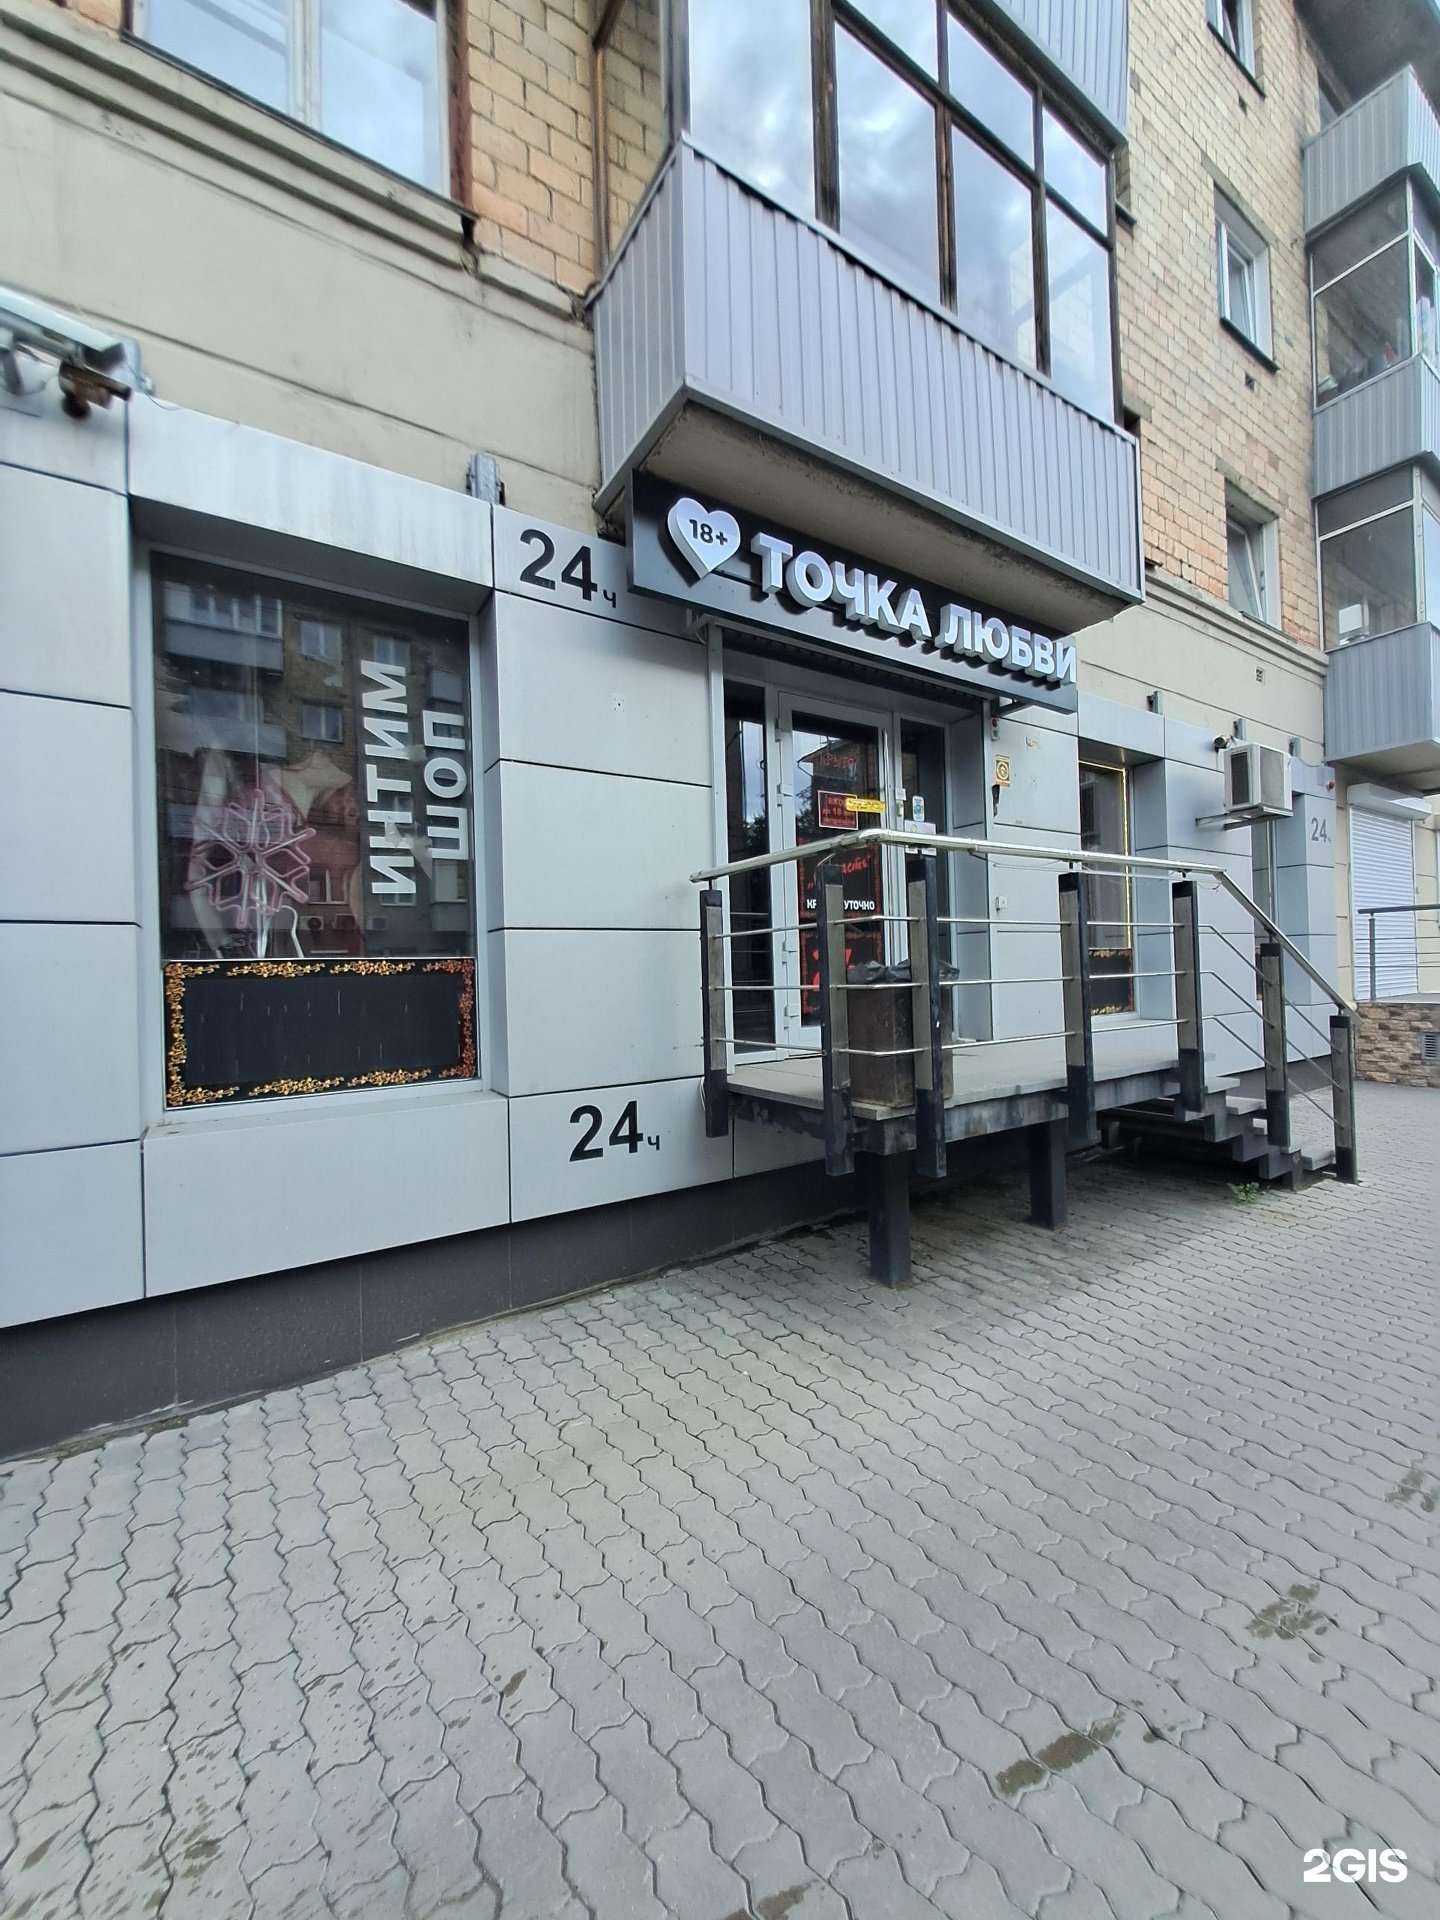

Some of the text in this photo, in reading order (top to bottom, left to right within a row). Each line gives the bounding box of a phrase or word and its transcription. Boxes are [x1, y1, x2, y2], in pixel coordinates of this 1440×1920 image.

[688, 518, 728, 546] 18+
[751, 531, 1077, 687] ТОЧКА ЛЮБВИ
[360, 659, 417, 894] ИНТИМ
[422, 709, 469, 860] ШОП
